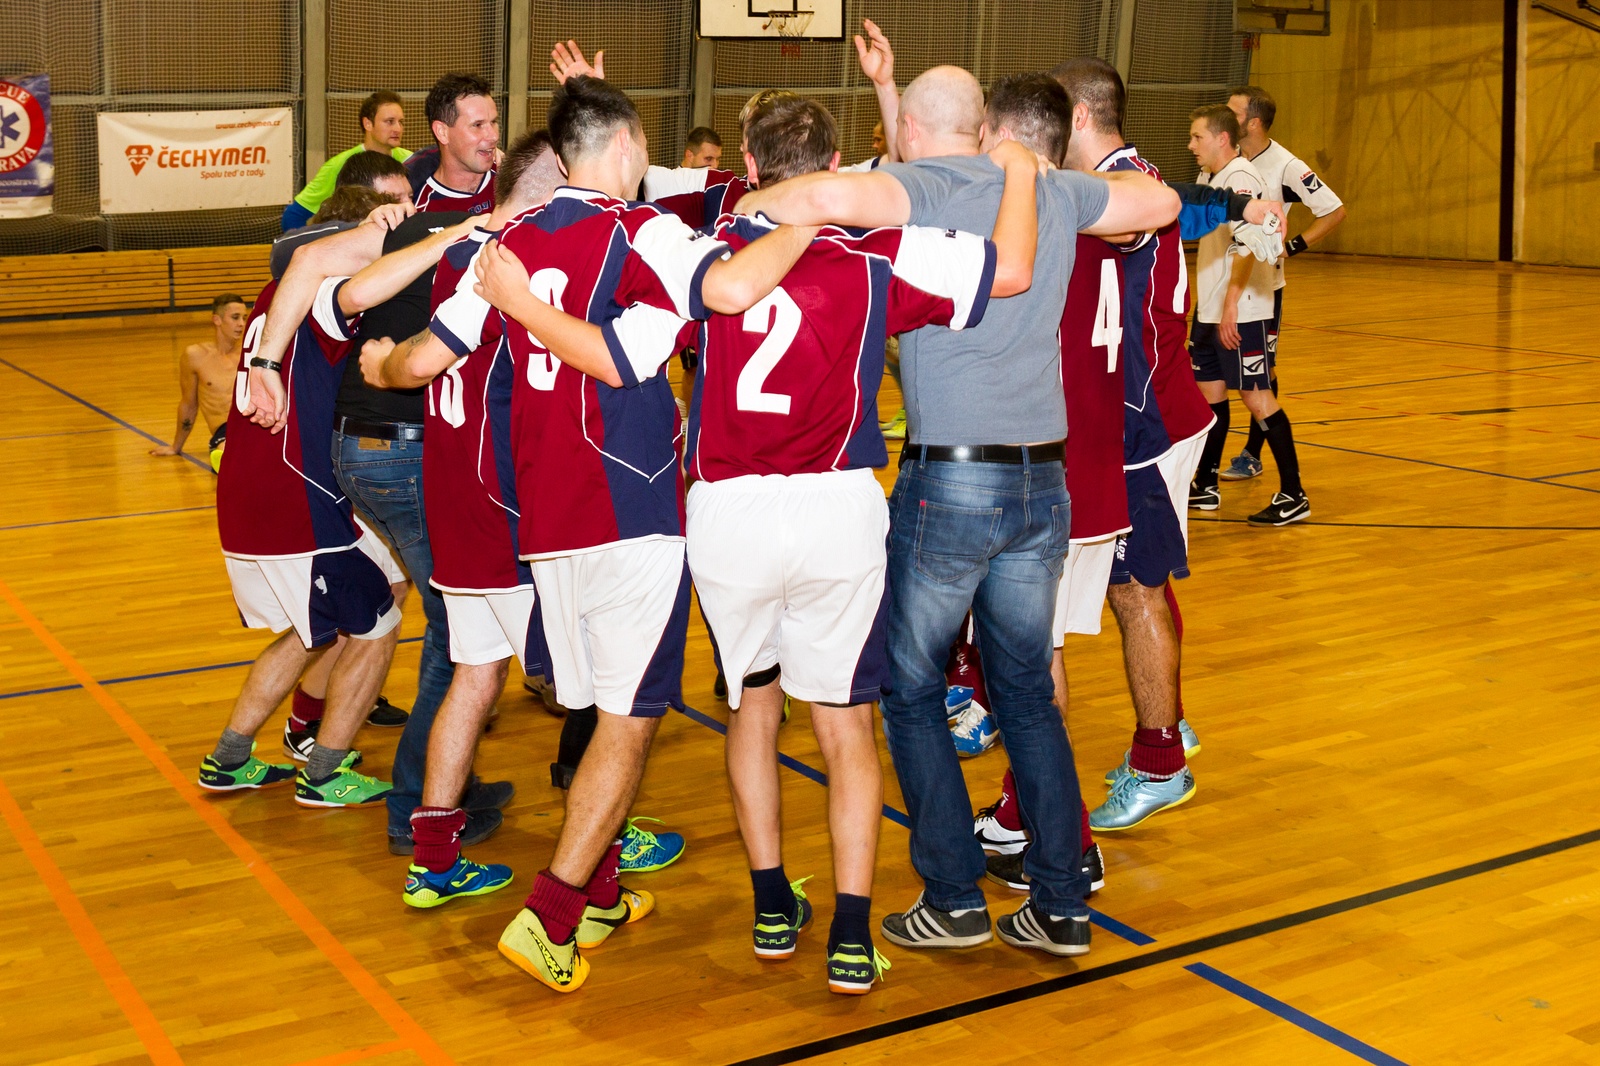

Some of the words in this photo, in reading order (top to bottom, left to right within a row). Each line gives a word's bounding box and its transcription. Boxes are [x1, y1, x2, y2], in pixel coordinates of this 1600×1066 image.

[215, 120, 281, 130] www.cechymen.cz
[157, 145, 267, 168] ČECHYMEN
[200, 170, 223, 180] Spolu
[224, 169, 239, 177] teď
[246, 168, 266, 177] tady.
[527, 267, 569, 391] 9
[1091, 258, 1124, 374] 4
[235, 312, 267, 414] 3
[736, 286, 803, 415] 2
[832, 966, 869, 977] TOP-FLEX
